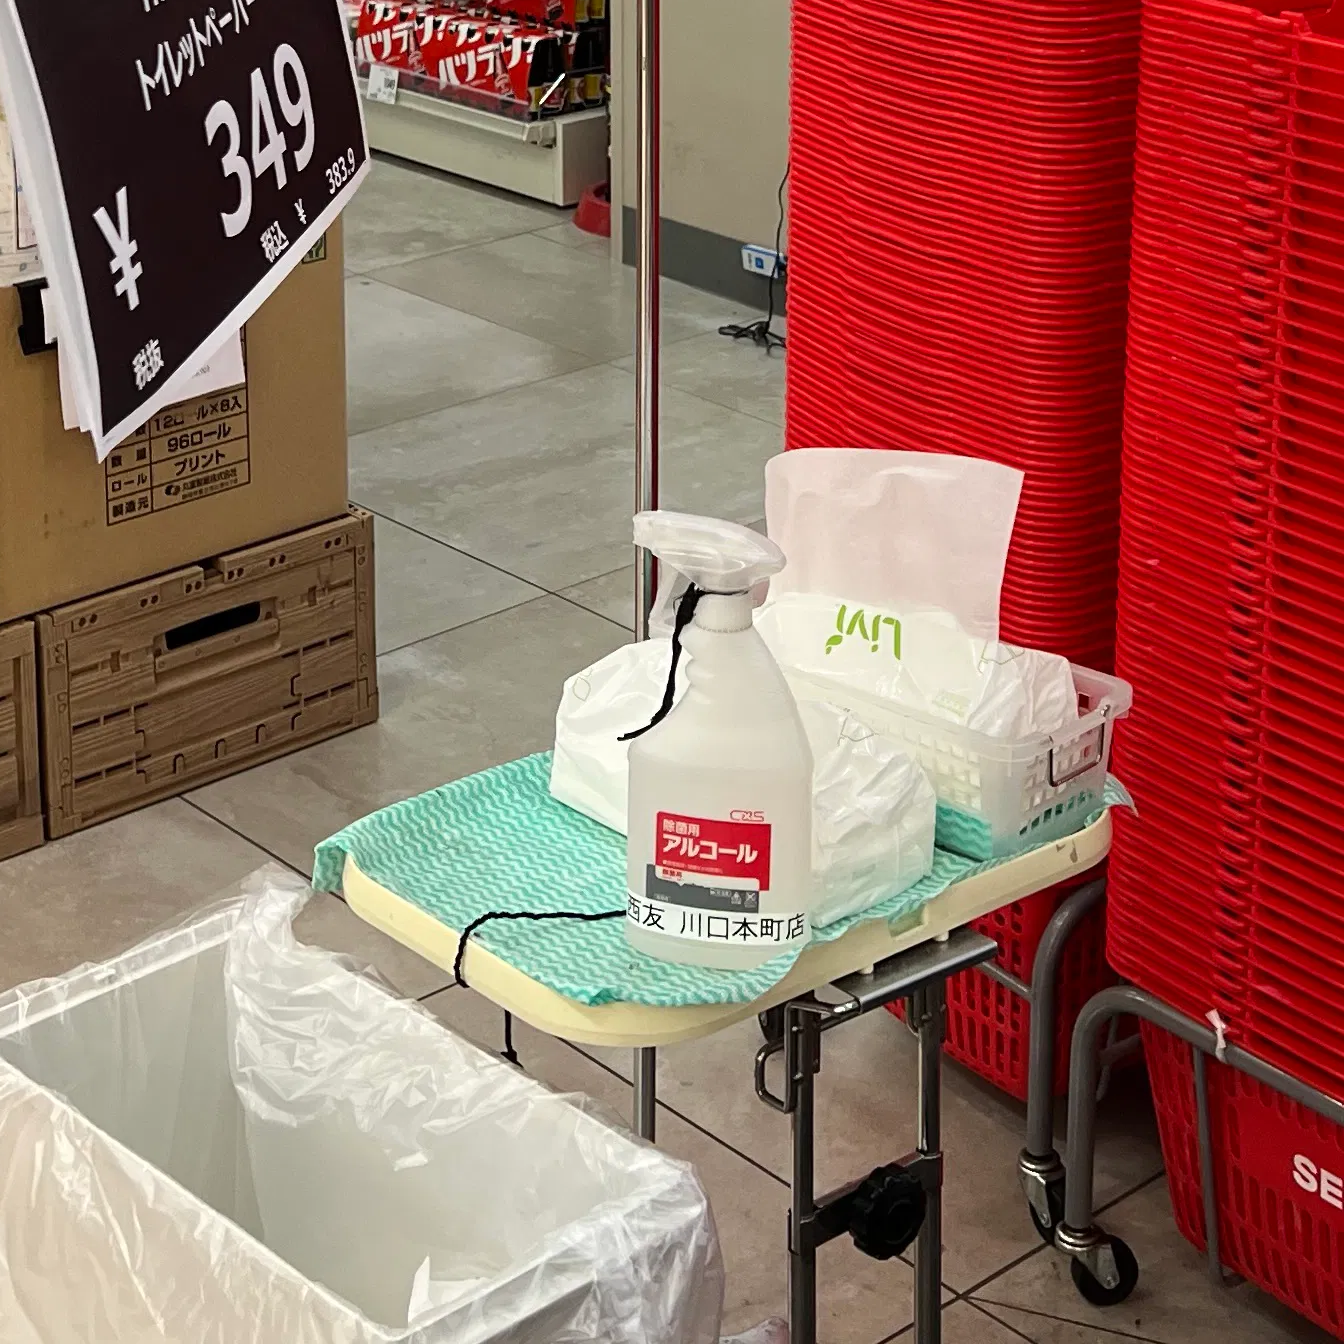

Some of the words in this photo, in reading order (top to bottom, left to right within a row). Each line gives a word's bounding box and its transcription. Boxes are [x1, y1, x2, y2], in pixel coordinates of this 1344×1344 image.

[90, 185, 144, 313] ¥
[203, 41, 316, 238] 349
[260, 222, 289, 263] 税込
[324, 145, 356, 196] 383.9
[132, 338, 165, 391] 税抜
[167, 423, 232, 452] 96ロール
[174, 449, 225, 477] プリント
[662, 834, 758, 864] アルコール
[680, 910, 805, 942] 川口本町店
